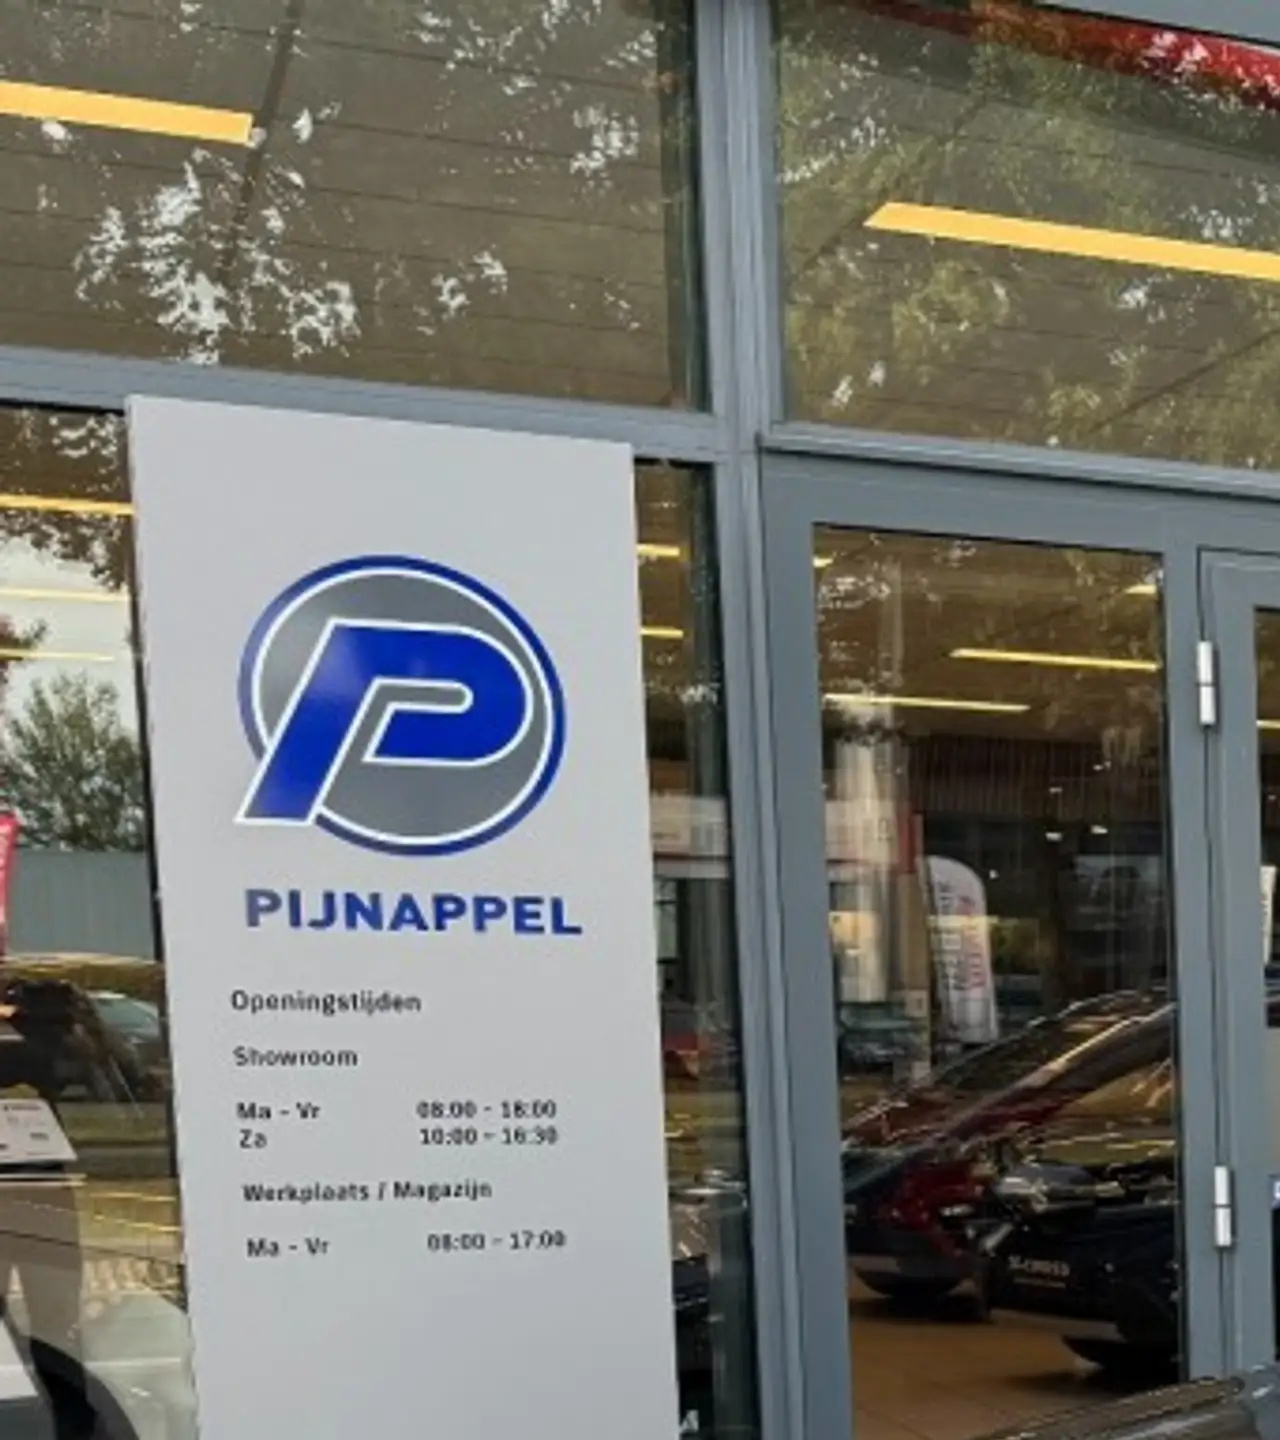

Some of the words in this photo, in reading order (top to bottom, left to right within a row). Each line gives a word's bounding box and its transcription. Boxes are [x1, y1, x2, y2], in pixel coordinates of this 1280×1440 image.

[245, 888, 584, 936] PIJNAPPEL
[231, 989, 422, 1017] Openingstijden
[232, 1045, 359, 1067] Showroom
[236, 1101, 272, 1121] Ma
[295, 1100, 321, 1120] Vr
[239, 1128, 268, 1149] Za
[419, 1127, 478, 1145] 10:00
[242, 1181, 370, 1204] Werkplaats
[377, 1181, 387, 1201] /
[393, 1177, 493, 1203] Magazijn
[247, 1237, 280, 1258] Ma
[305, 1237, 331, 1255] Vr
